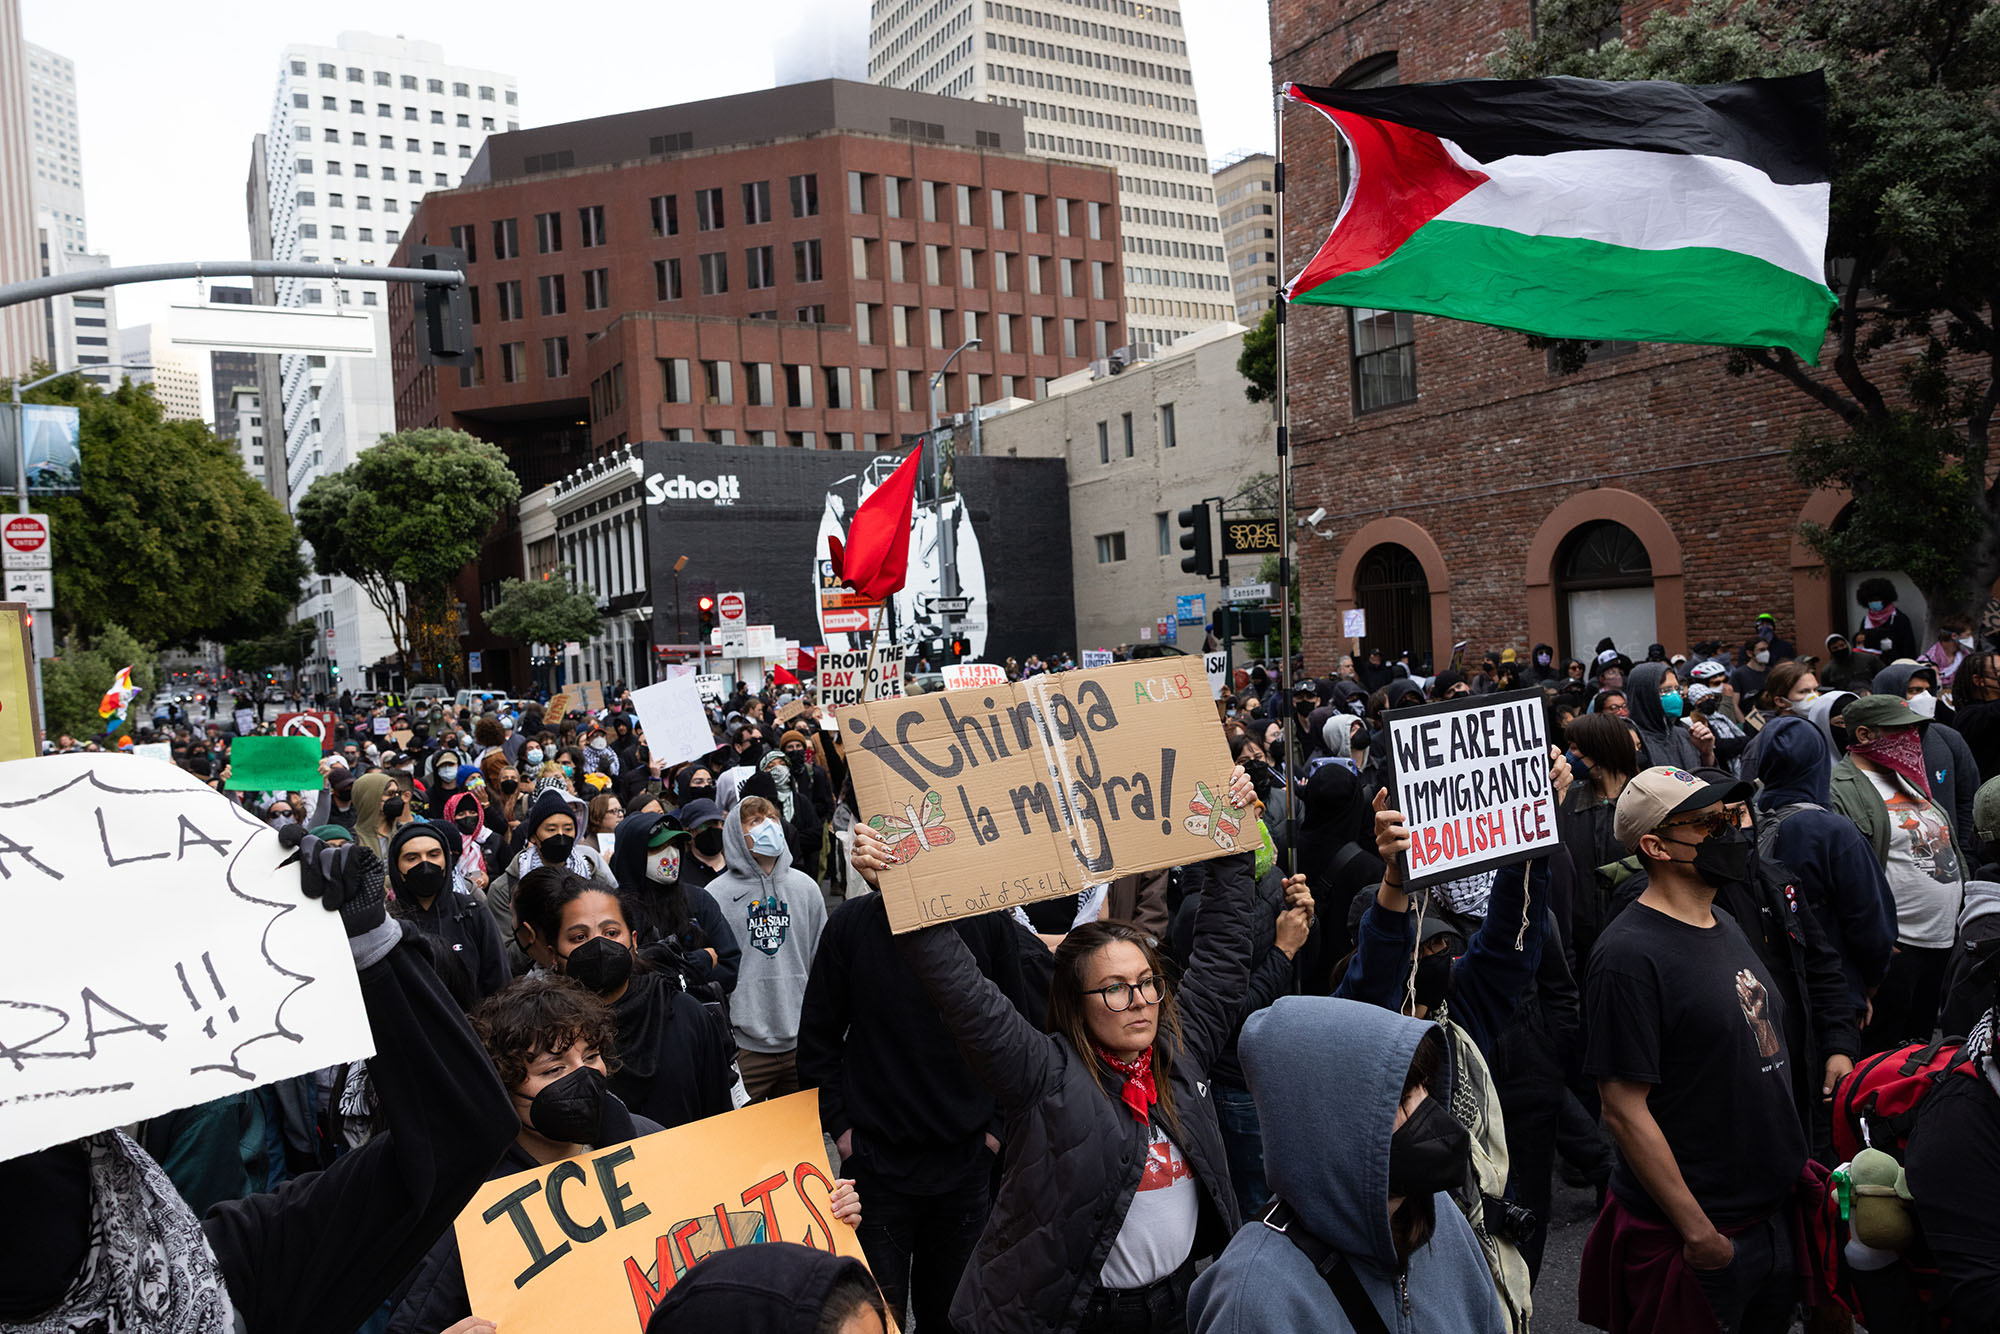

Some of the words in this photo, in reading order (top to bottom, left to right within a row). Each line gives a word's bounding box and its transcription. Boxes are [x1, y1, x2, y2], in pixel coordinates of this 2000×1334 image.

[645, 473, 740, 504] Schott
[1229, 523, 1276, 539] SPOKE
[1233, 588, 1265, 598] Sansome
[820, 652, 868, 670] FROM
[879, 646, 904, 663] THE
[958, 666, 999, 677] FIGHT
[822, 671, 854, 687] BAY
[882, 663, 898, 681] LA
[1134, 674, 1193, 705] ACAB
[1394, 719, 1444, 774] WE
[1450, 709, 1500, 763] ARE
[1502, 703, 1543, 756] ALL
[1404, 753, 1549, 827] IMMIGRANTS!
[957, 785, 1000, 846] la
[1009, 748, 1176, 873] migra!
[95, 806, 233, 868] LA
[1411, 809, 1507, 870] ABOLISH
[1512, 799, 1551, 845] ICE
[965, 886, 991, 911] out
[997, 881, 1010, 904] of
[749, 916, 767, 930] ALL
[767, 915, 789, 927] STAR
[755, 926, 780, 938] GAME
[482, 1145, 652, 1290] ICE
